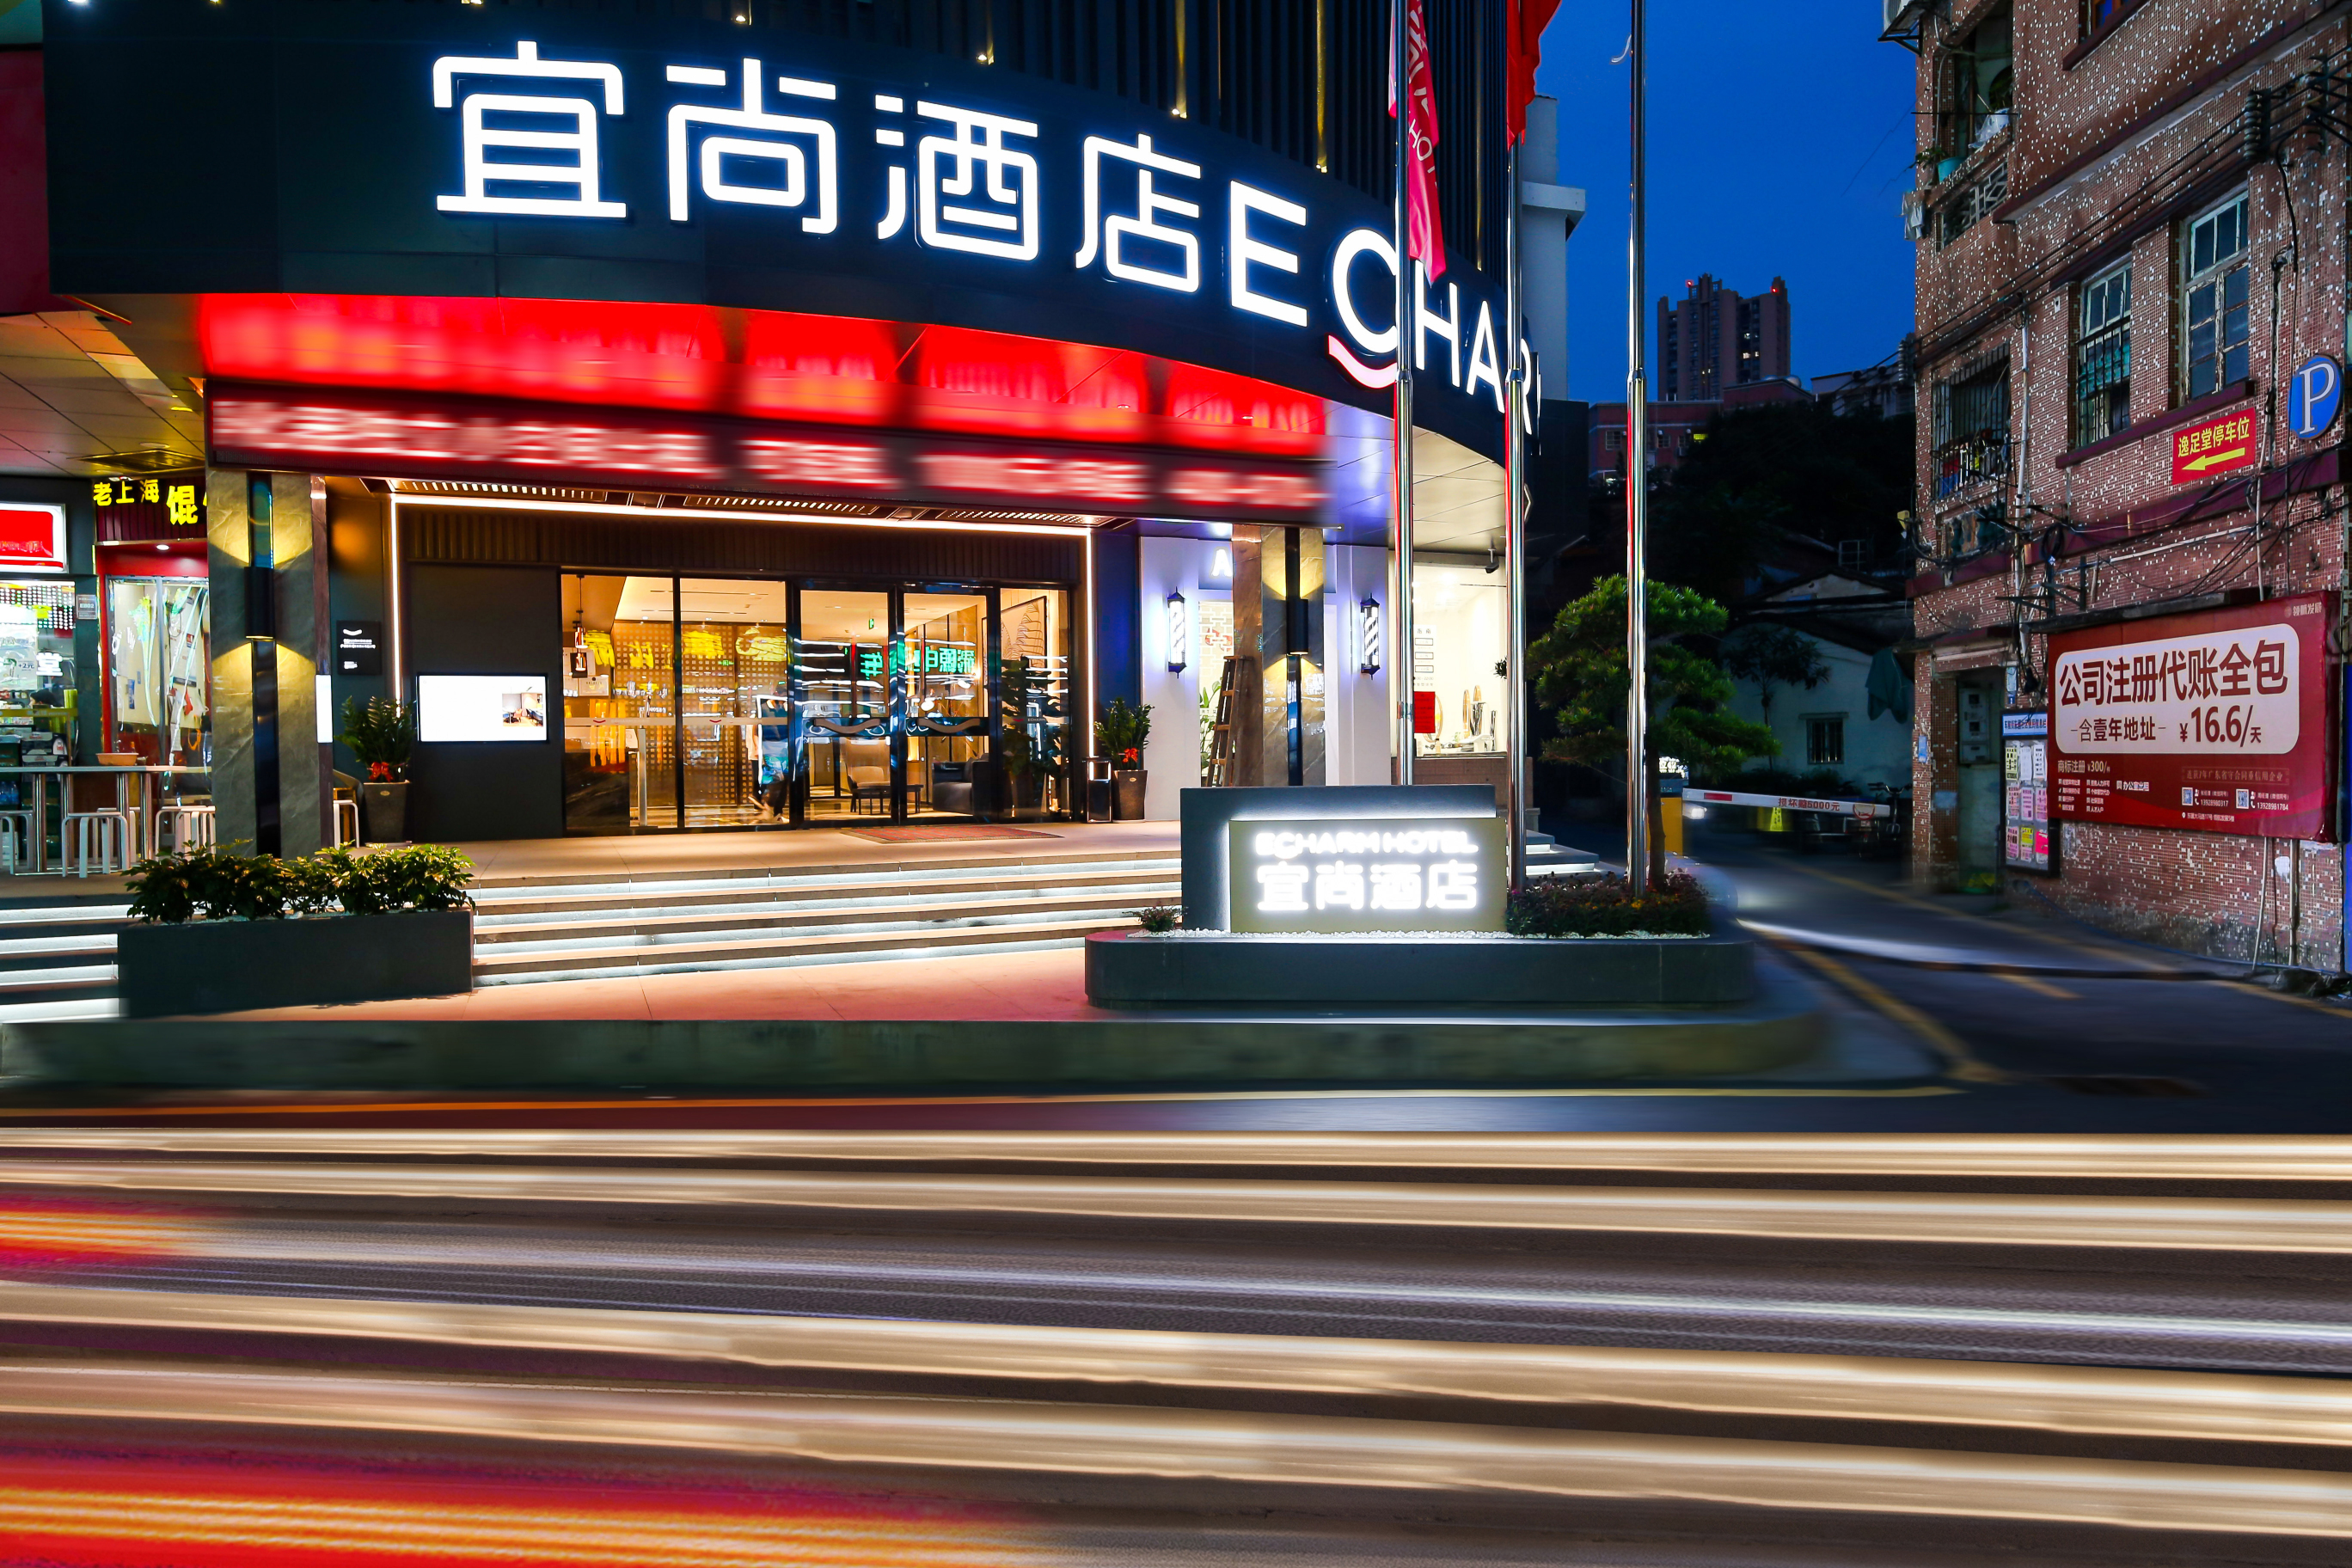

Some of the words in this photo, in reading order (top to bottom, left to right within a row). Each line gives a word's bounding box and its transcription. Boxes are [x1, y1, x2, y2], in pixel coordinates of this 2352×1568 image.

[432, 40, 1202, 293] 宜尚酒店
[1230, 180, 1541, 456] ECHAR
[2300, 363, 2335, 435] P
[2177, 416, 2251, 458] 逸足堂停车位
[93, 479, 160, 506] 老上海
[166, 485, 207, 526] 馄
[2059, 639, 2288, 707] 公司注册代账全包
[2079, 716, 2157, 743] 含壹年地址
[2057, 760, 2086, 774] 商标注册
[1257, 860, 1478, 911] 宜尚酒店
